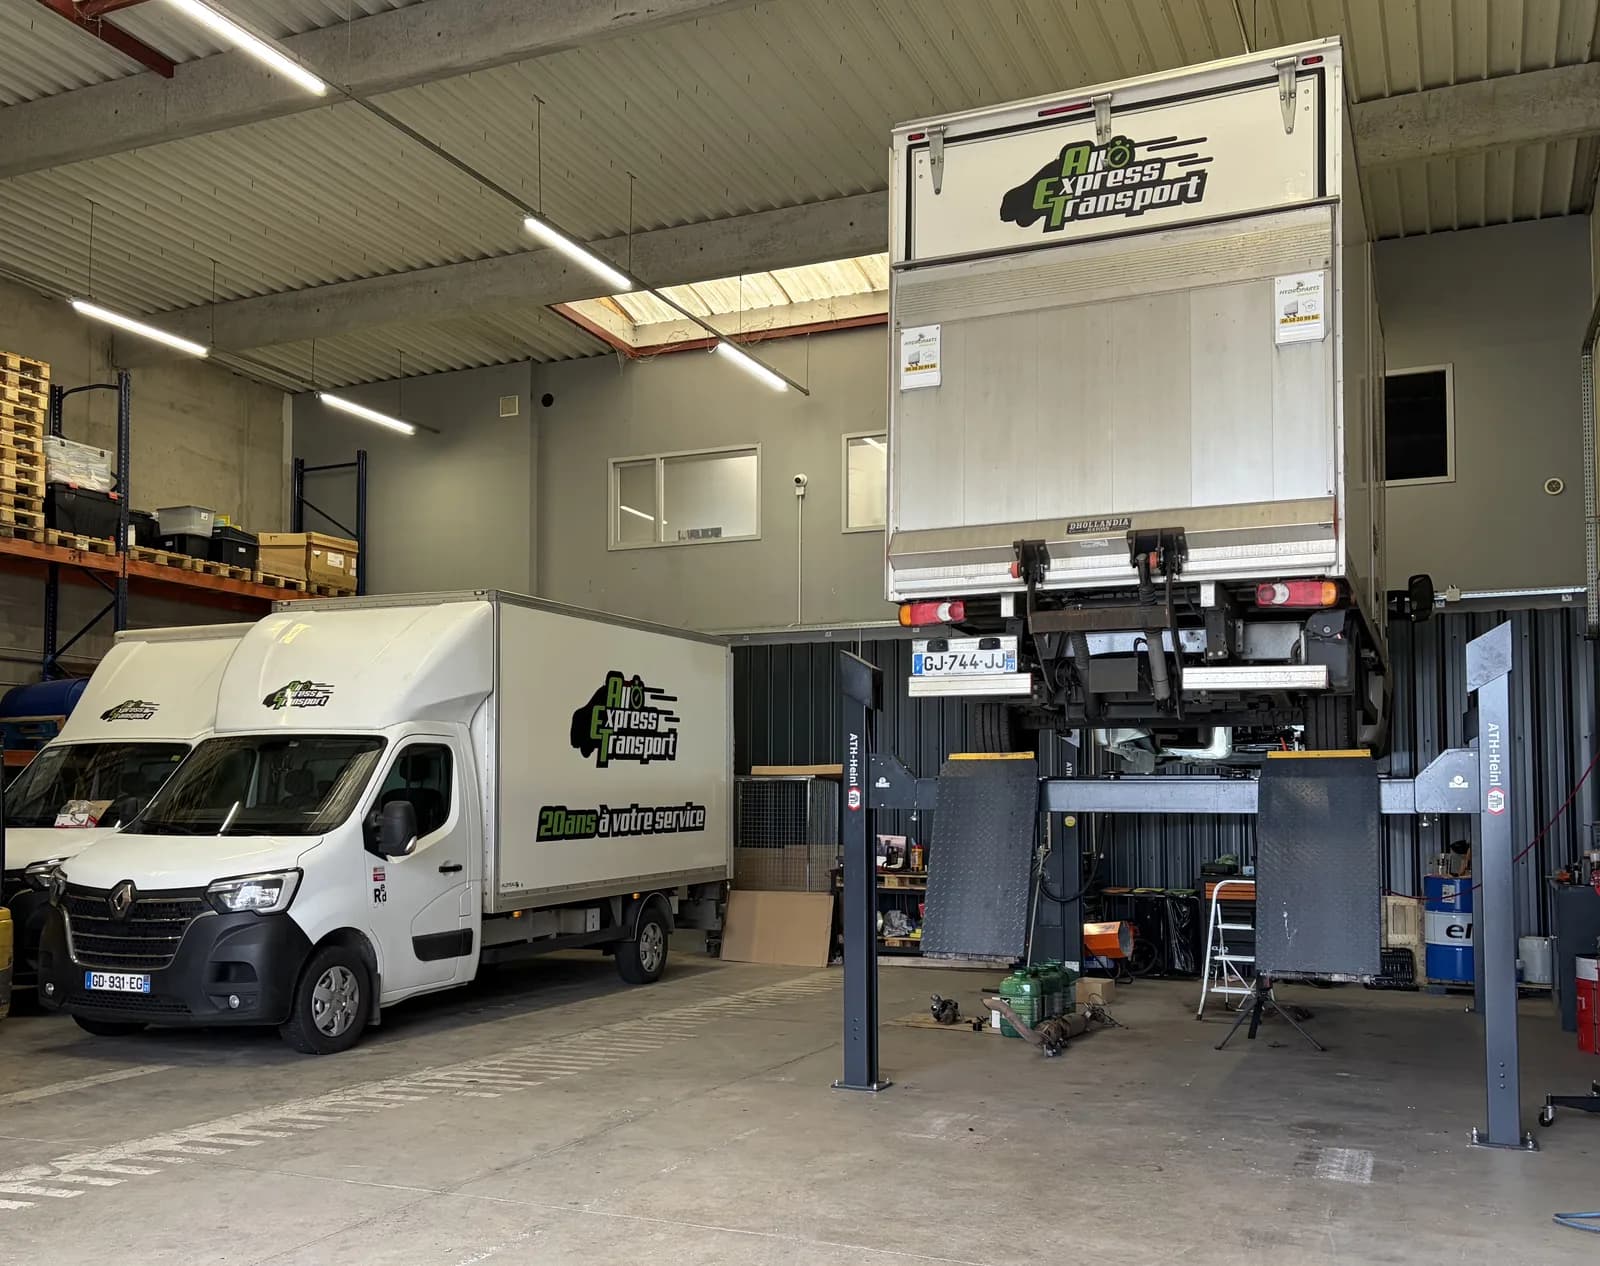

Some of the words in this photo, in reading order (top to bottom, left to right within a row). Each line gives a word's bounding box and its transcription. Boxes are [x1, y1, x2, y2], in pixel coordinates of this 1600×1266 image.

[1032, 161, 1161, 210] Express
[1049, 174, 1201, 227] Transport
[1069, 518, 1129, 530] DHOLLANDIA
[274, 695, 328, 709] Trnsport
[590, 705, 658, 739] Express
[599, 728, 676, 762] Transport
[849, 733, 859, 786] ATH-Heinl
[1488, 722, 1502, 786] ATH-Heinl
[612, 808, 653, 833] votre
[655, 805, 705, 830] service
[1445, 923, 1473, 939] el
